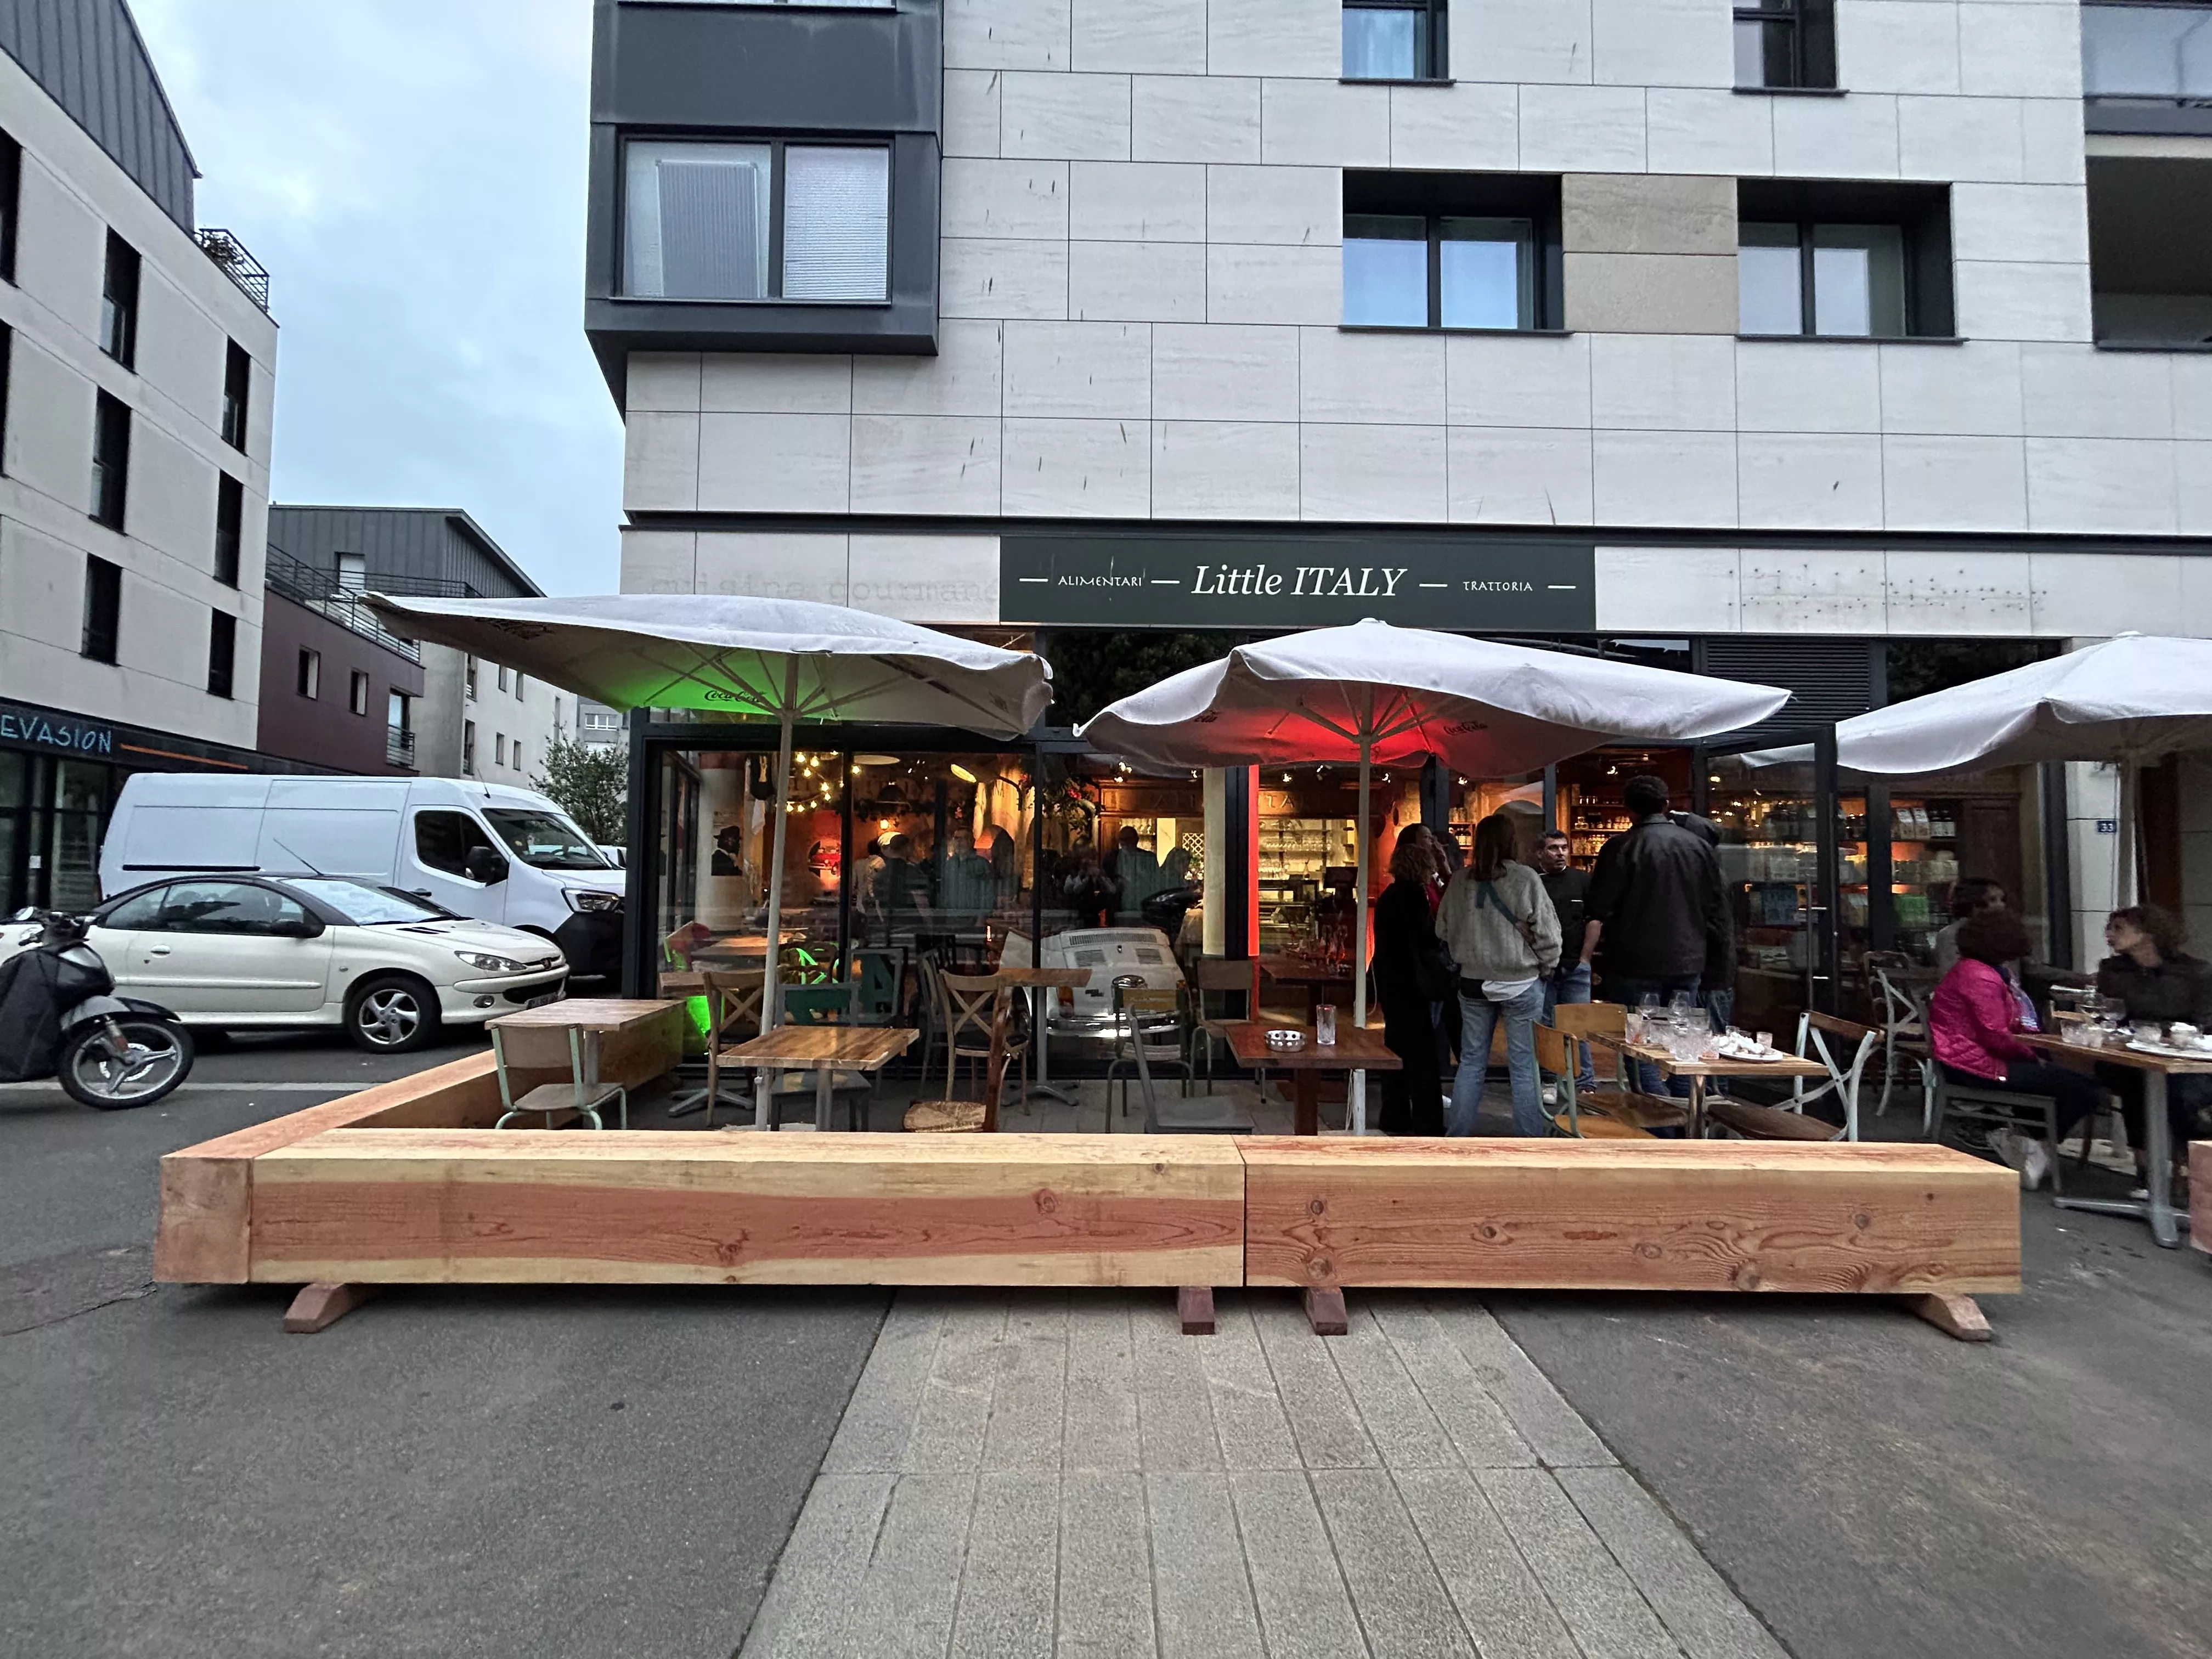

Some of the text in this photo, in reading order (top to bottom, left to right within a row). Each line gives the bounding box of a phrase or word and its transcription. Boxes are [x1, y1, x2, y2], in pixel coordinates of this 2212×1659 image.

[1058, 564, 1533, 596] ALIMENTARI Little ITALY TRATTORIA
[1, 714, 111, 753] EVASION
[2101, 823, 2113, 832] 33
